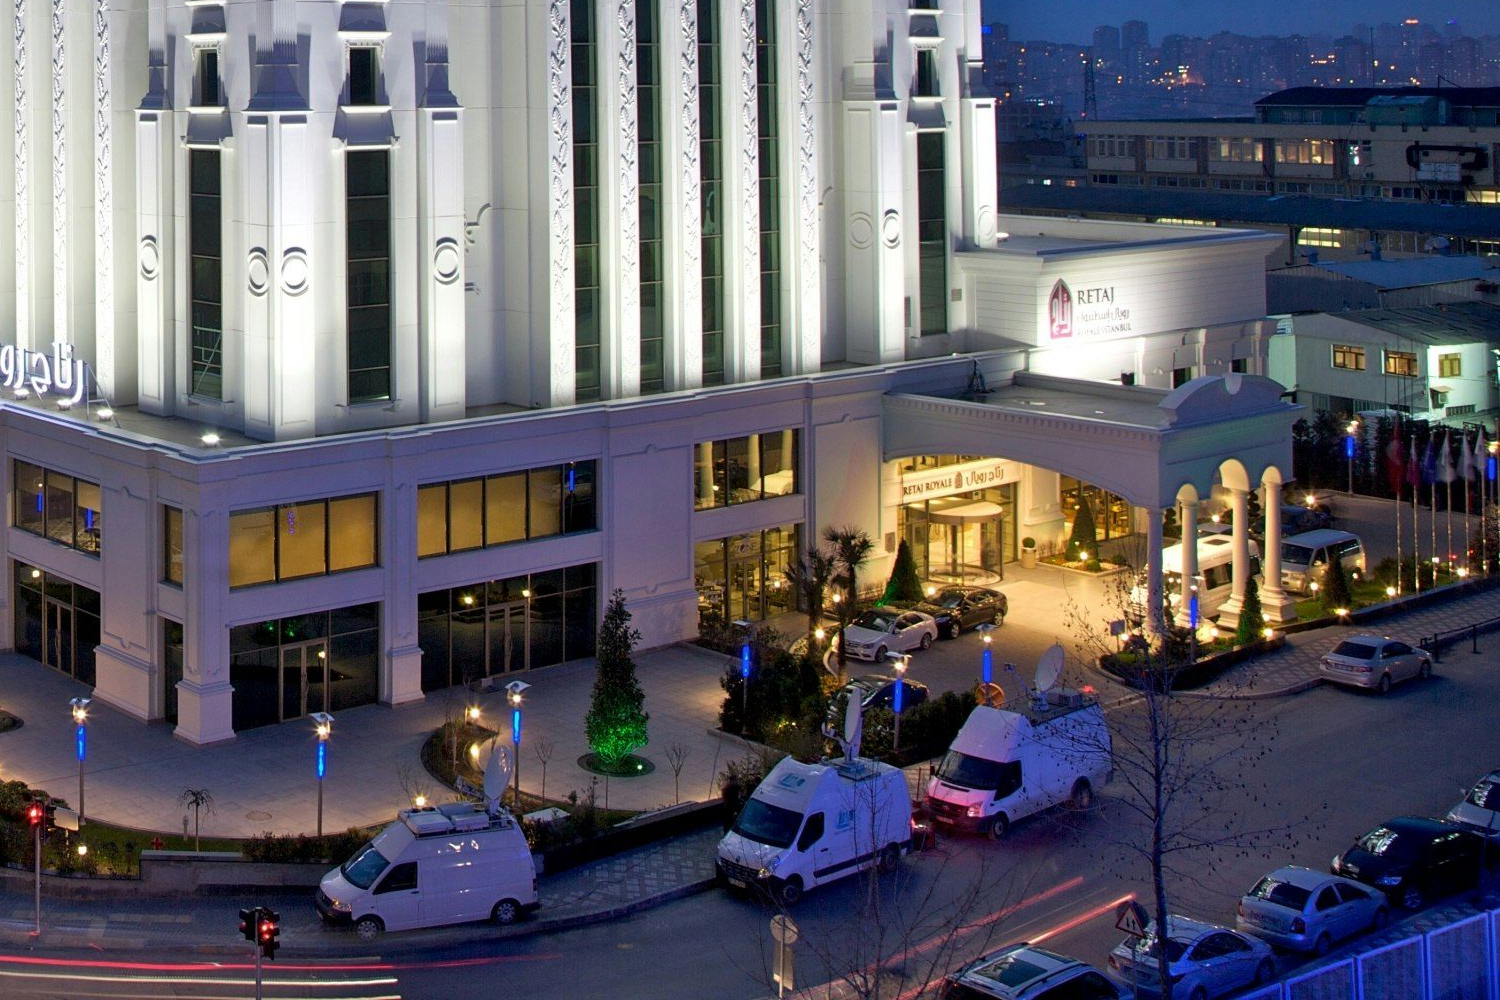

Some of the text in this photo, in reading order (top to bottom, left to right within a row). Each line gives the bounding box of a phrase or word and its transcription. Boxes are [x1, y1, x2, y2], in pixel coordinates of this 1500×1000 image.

[1077, 286, 1115, 305] RETAJ
[903, 477, 953, 496] RETAJ ROYALE
